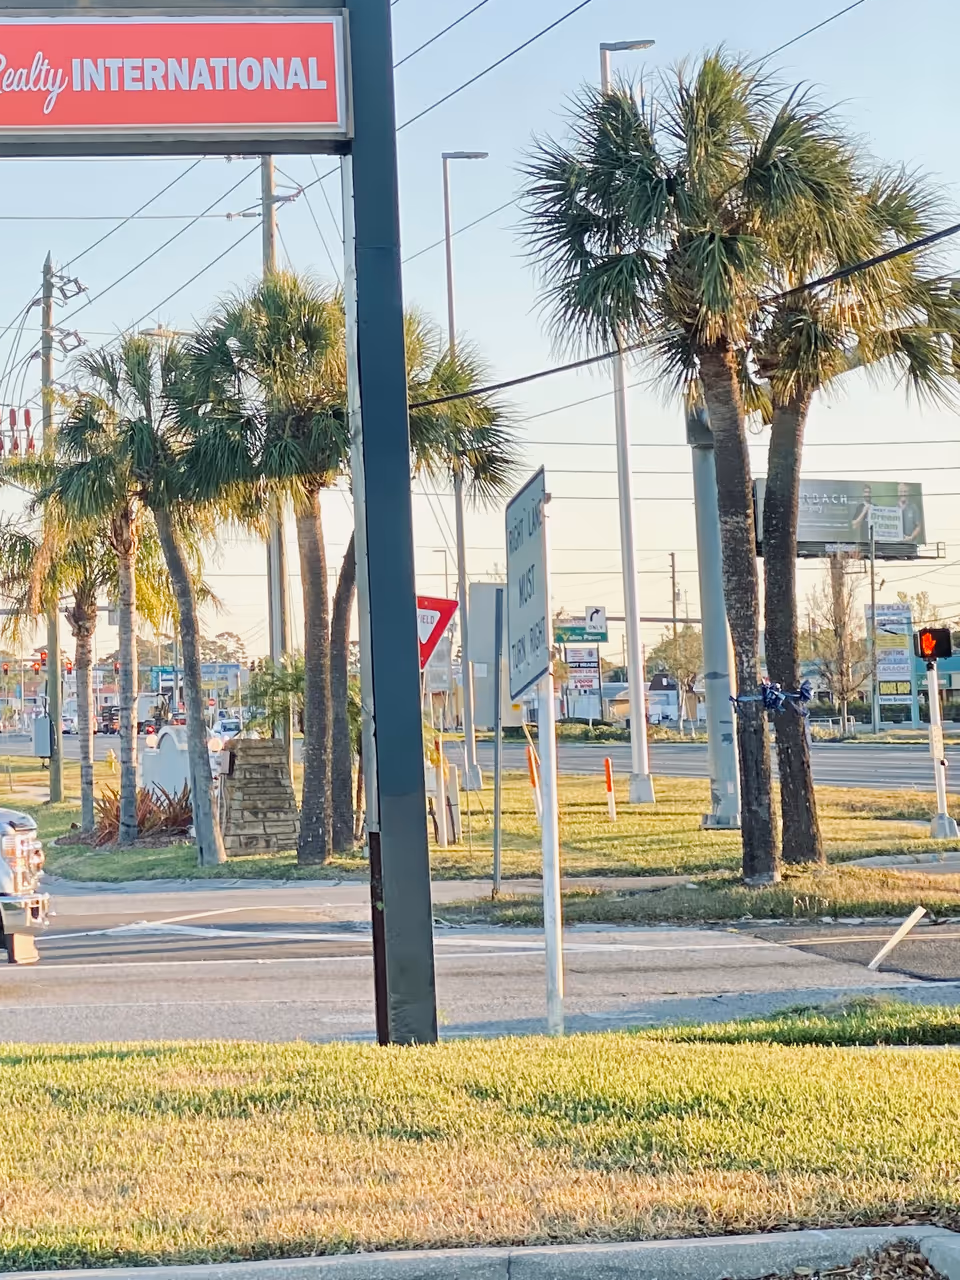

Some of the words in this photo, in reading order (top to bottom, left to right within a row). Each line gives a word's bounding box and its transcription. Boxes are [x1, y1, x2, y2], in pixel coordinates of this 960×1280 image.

[73, 58, 327, 91] INTERNATIONAL
[519, 564, 535, 608] MUST
[512, 635, 526, 670] TURN
[529, 616, 545, 654] RIGHT
